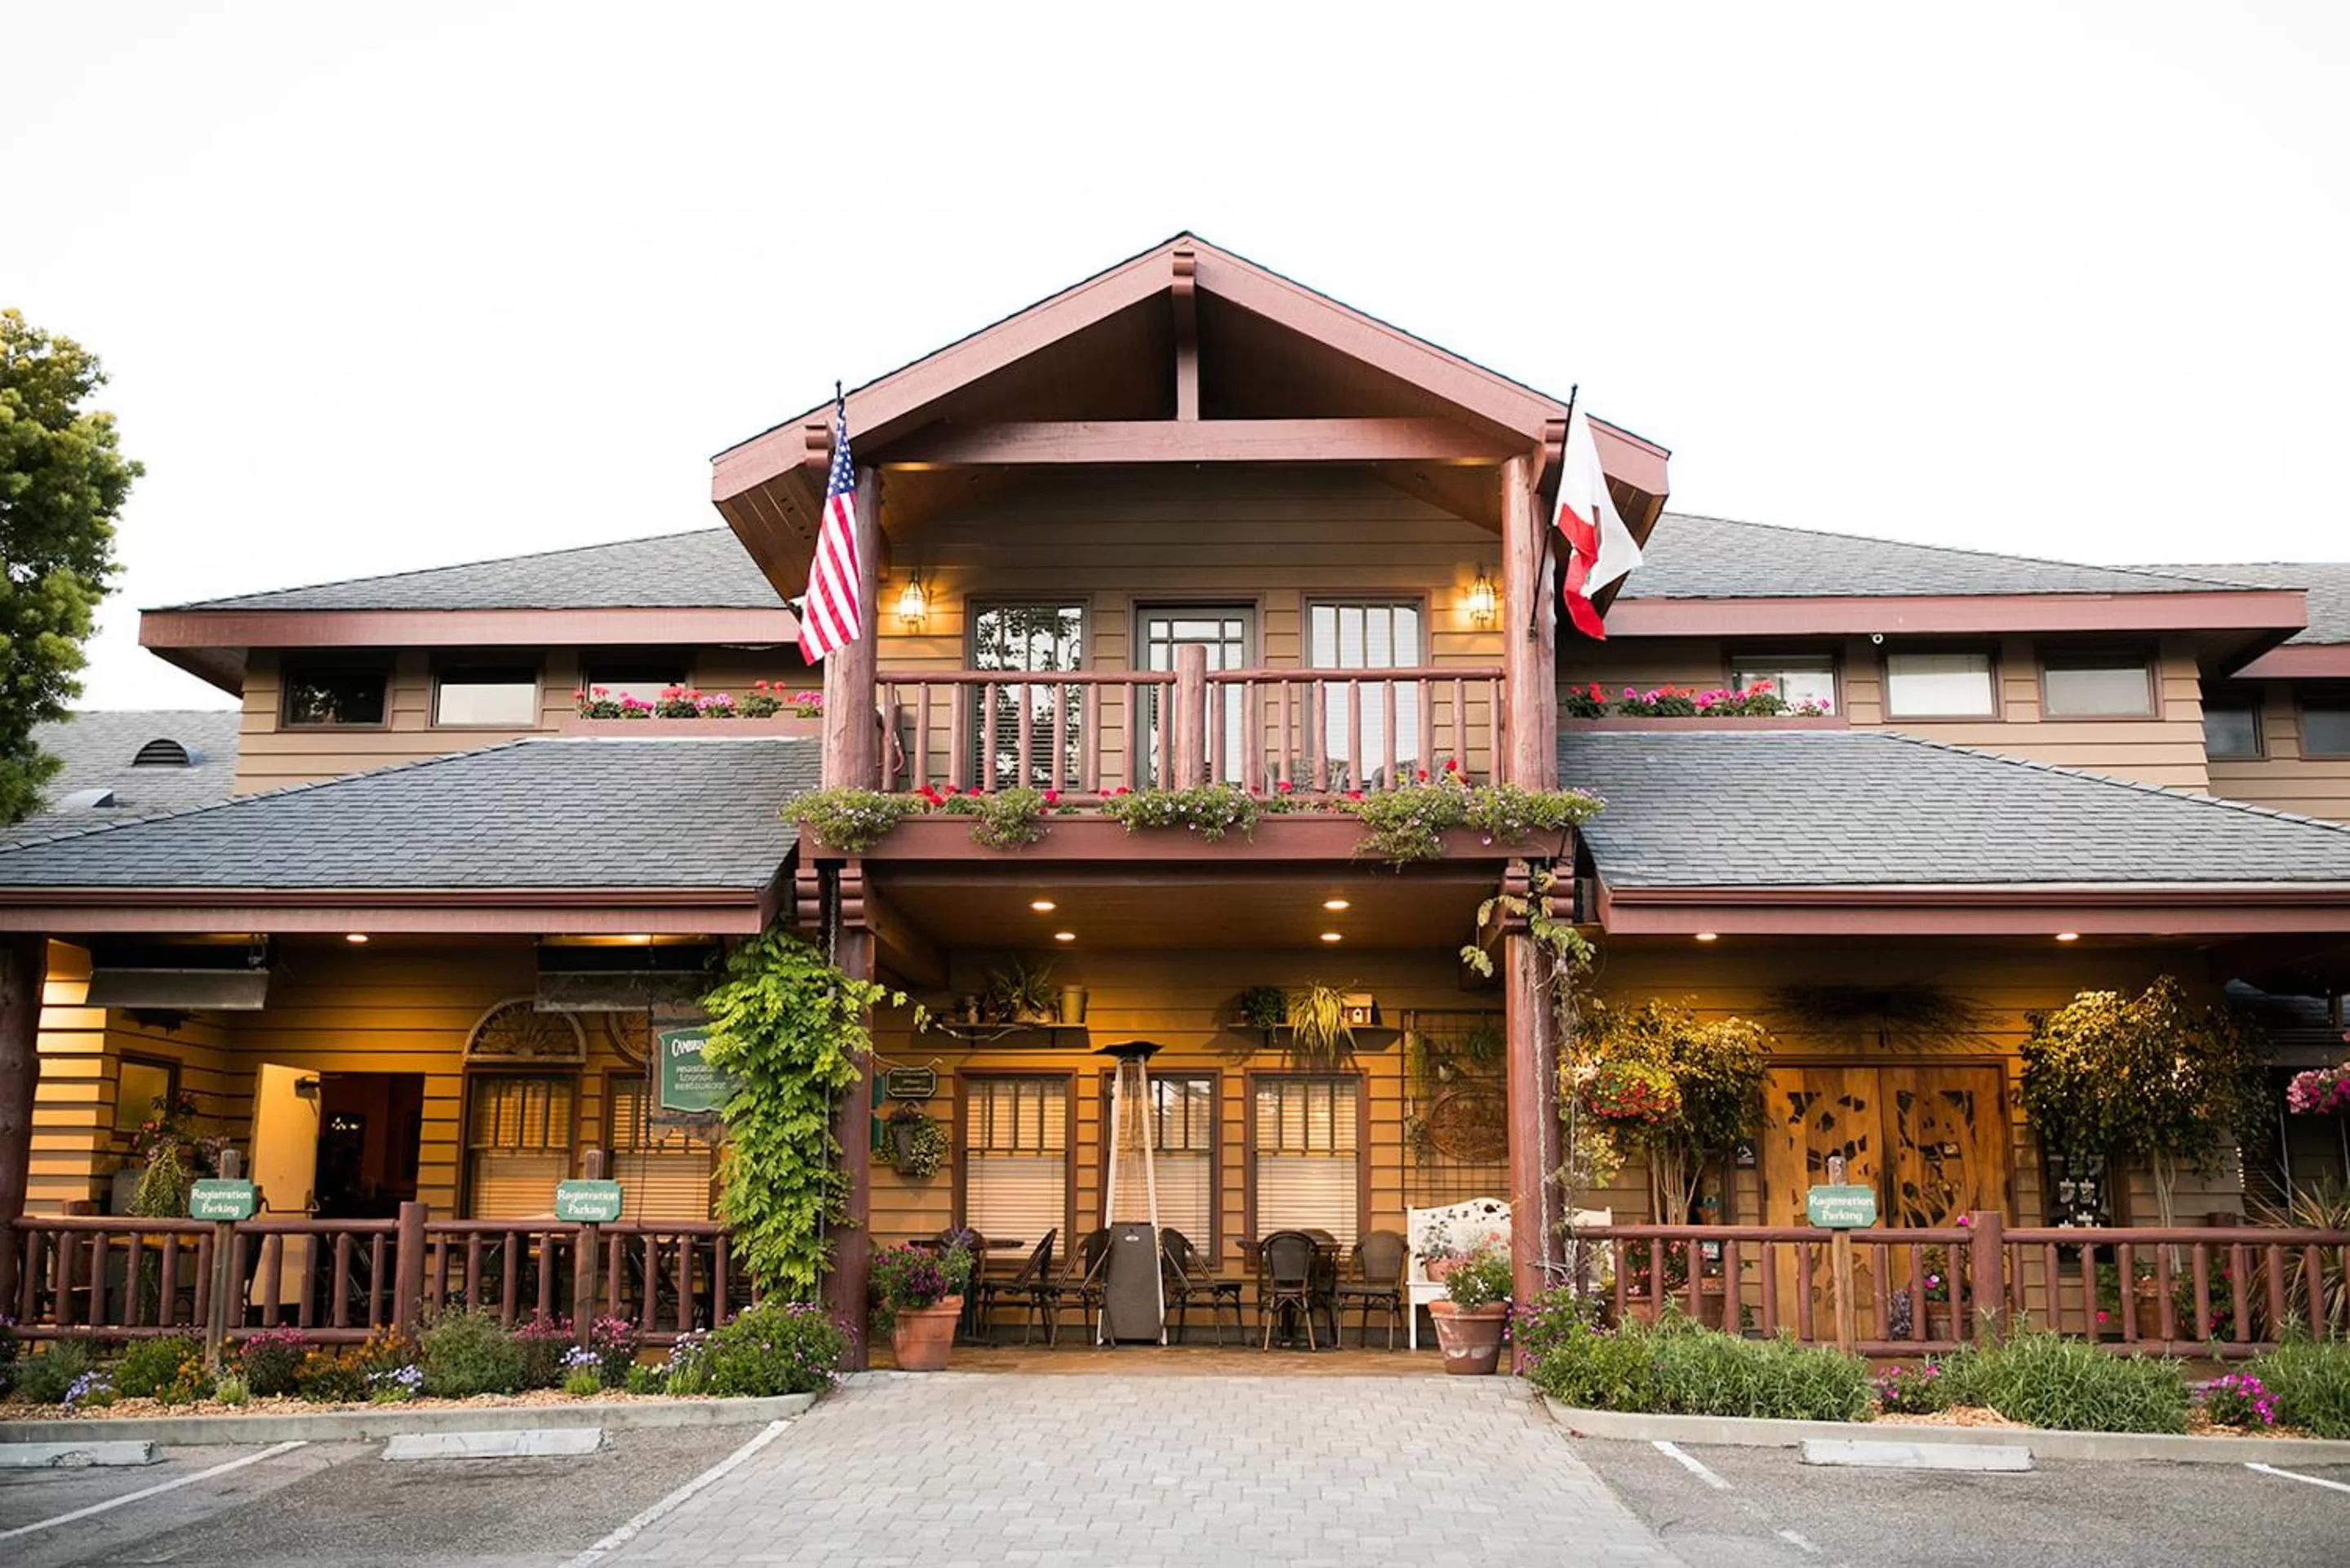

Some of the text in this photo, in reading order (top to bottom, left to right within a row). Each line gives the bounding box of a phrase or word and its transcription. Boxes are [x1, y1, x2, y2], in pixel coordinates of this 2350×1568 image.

[191, 1188, 252, 1203] Registration
[558, 1189, 619, 1204] Registration
[1809, 1194, 1874, 1209] Registration
[202, 1202, 239, 1217] Parking
[568, 1203, 607, 1218] Parking
[1822, 1210, 1864, 1224] Parking
